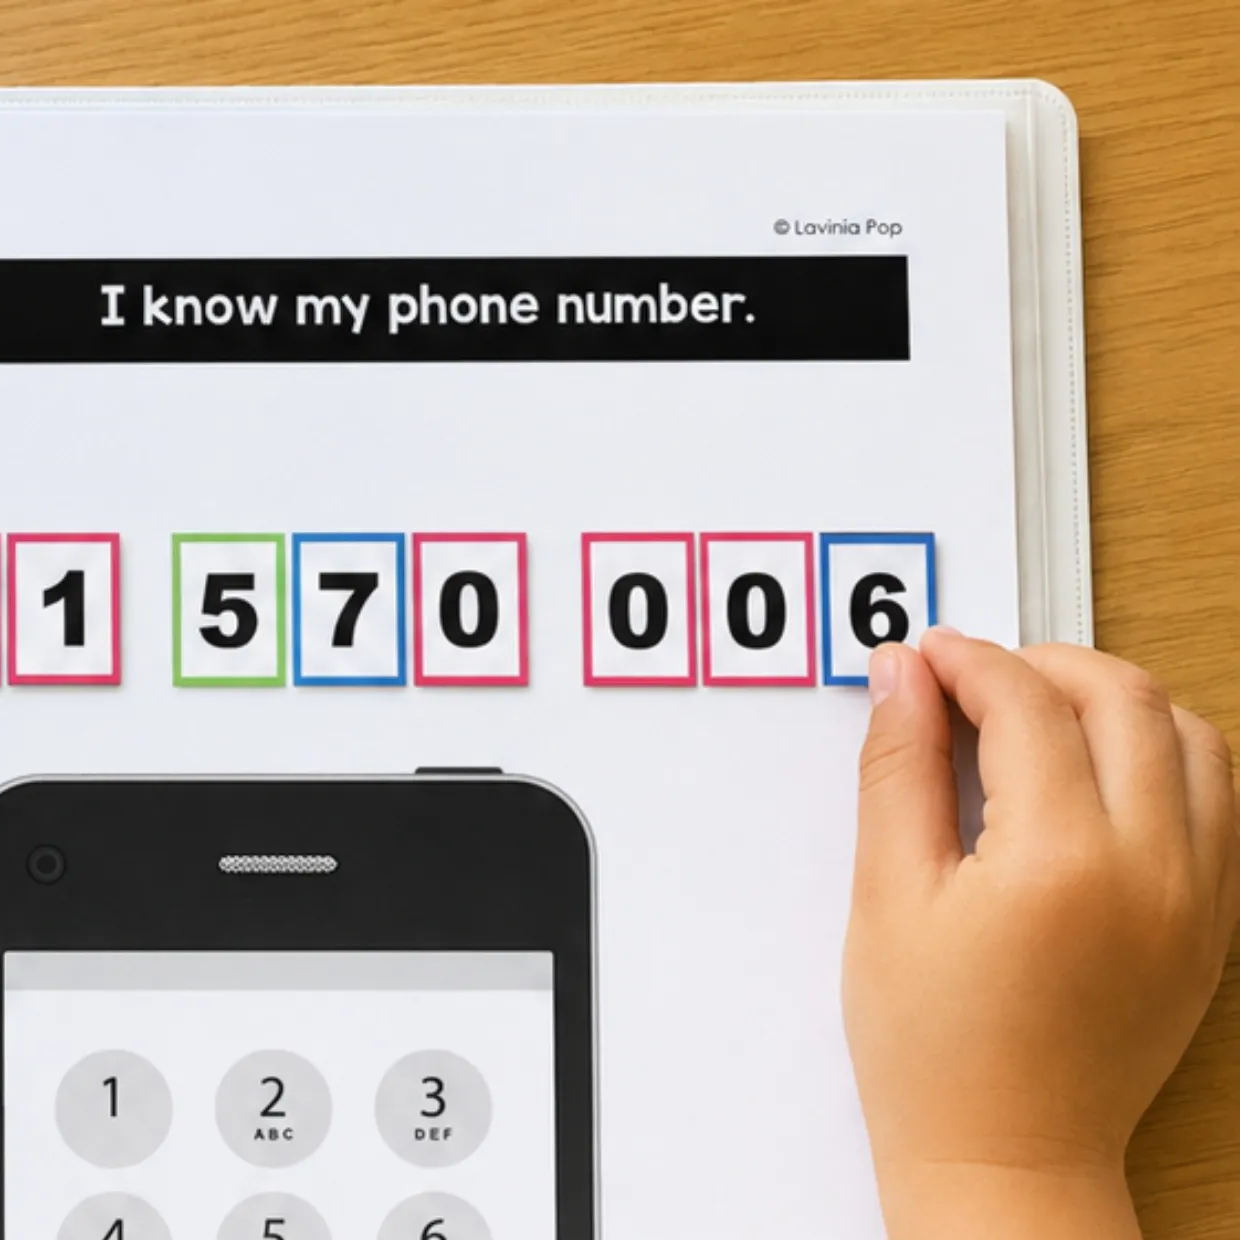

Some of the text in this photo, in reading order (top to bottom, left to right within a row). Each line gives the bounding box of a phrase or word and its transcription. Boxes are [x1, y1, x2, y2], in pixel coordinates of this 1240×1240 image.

[794, 219, 861, 236] Lavinia
[866, 218, 904, 240] Pop
[101, 282, 756, 335] I know my phone number.
[102, 1076, 117, 1117] 1
[260, 1076, 286, 1117] 2
[421, 1076, 446, 1118] 3
[253, 1128, 295, 1141] ABC
[414, 1128, 453, 1141] DEF
